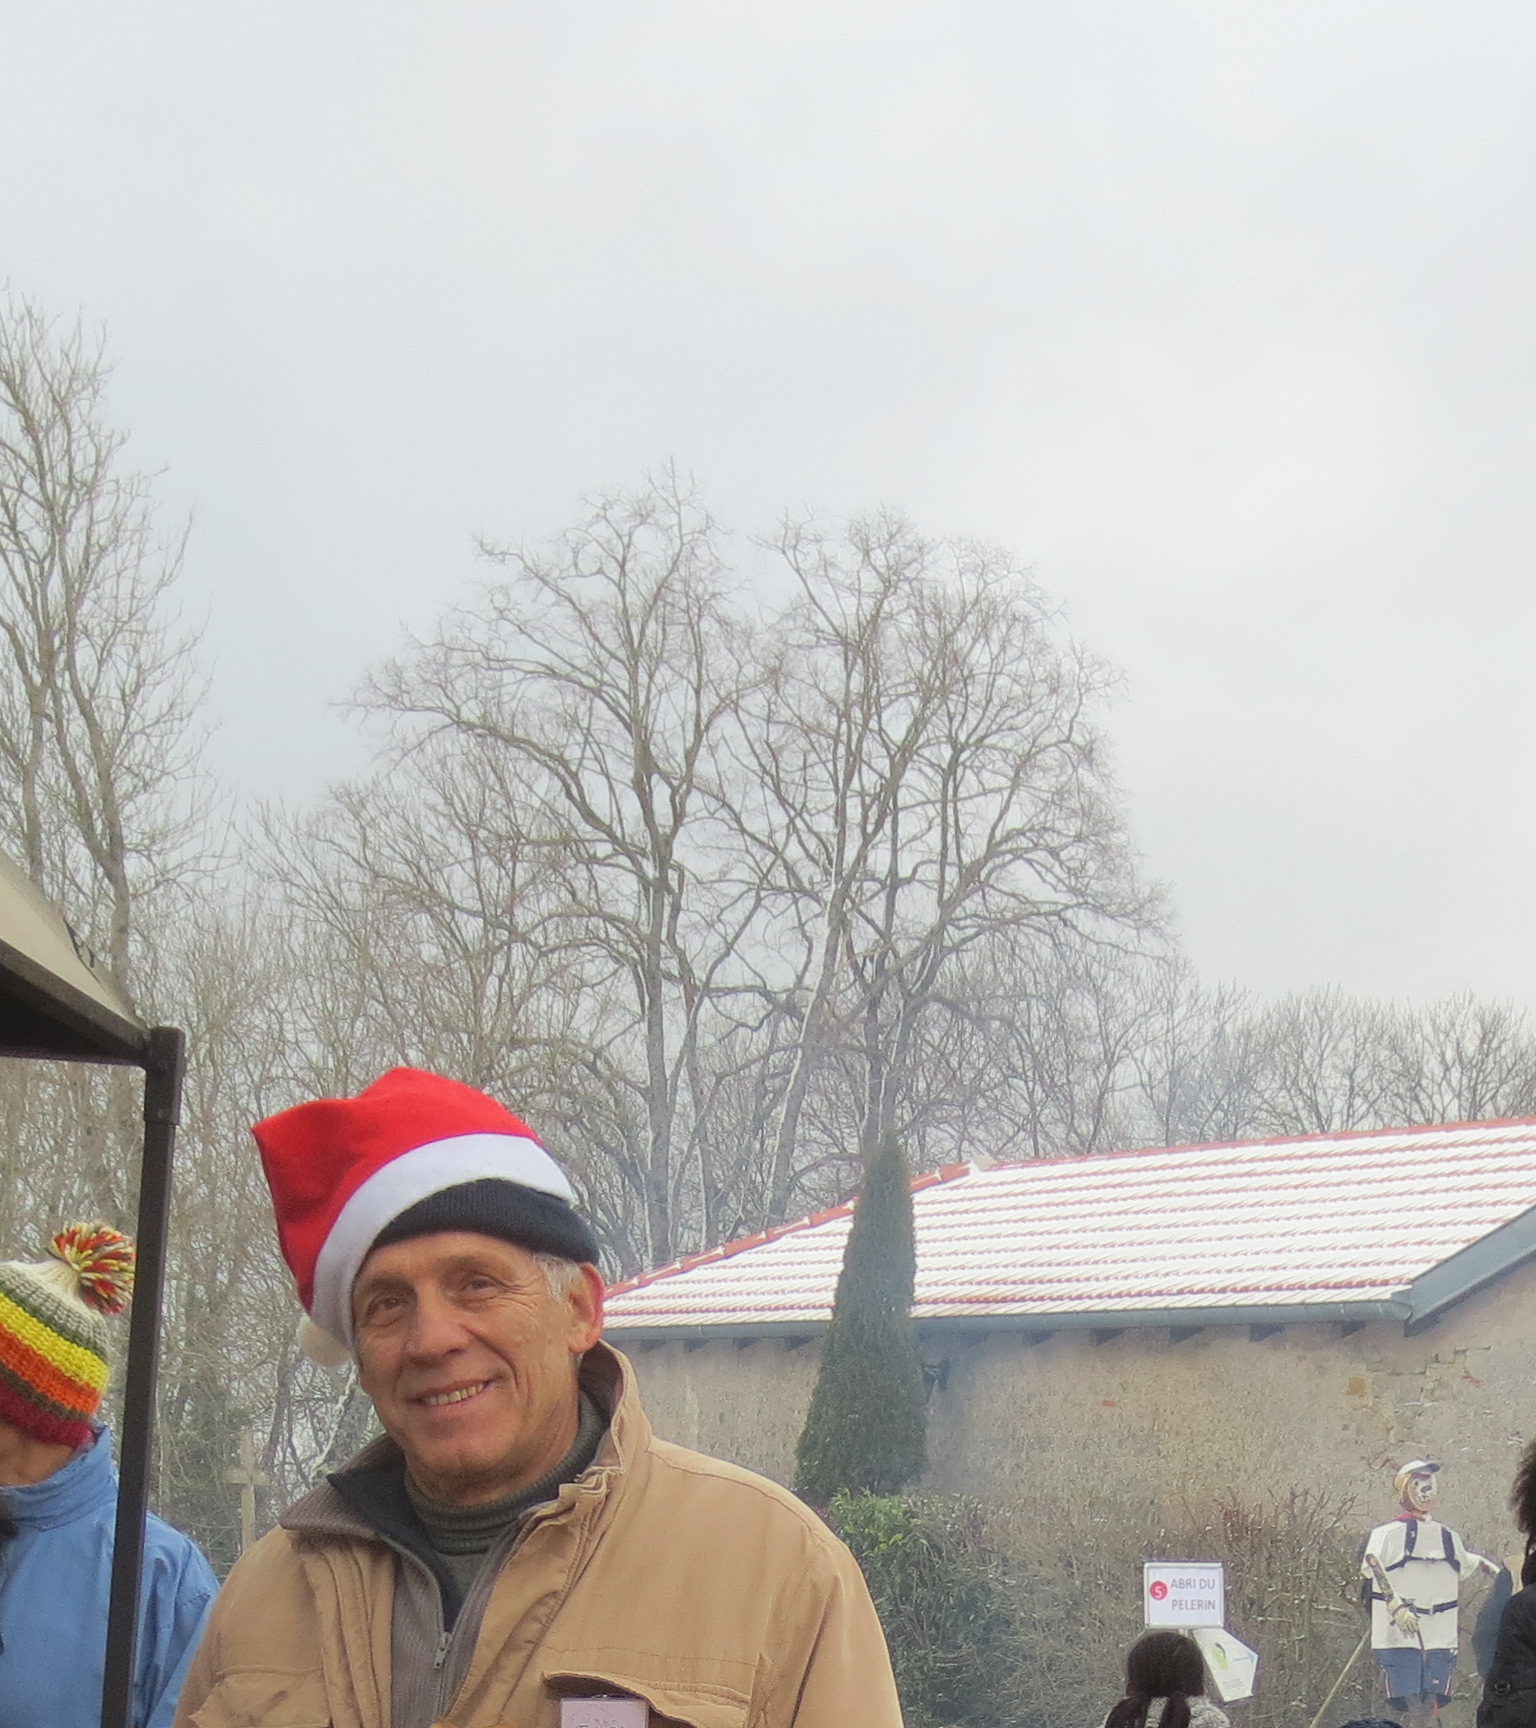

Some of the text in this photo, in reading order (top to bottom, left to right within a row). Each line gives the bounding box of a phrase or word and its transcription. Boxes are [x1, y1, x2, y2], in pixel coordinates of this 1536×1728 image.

[1170, 1579, 1216, 1590] ABRI DU
[1154, 1586, 1164, 1599] 5
[1171, 1600, 1216, 1611] PELERIN
